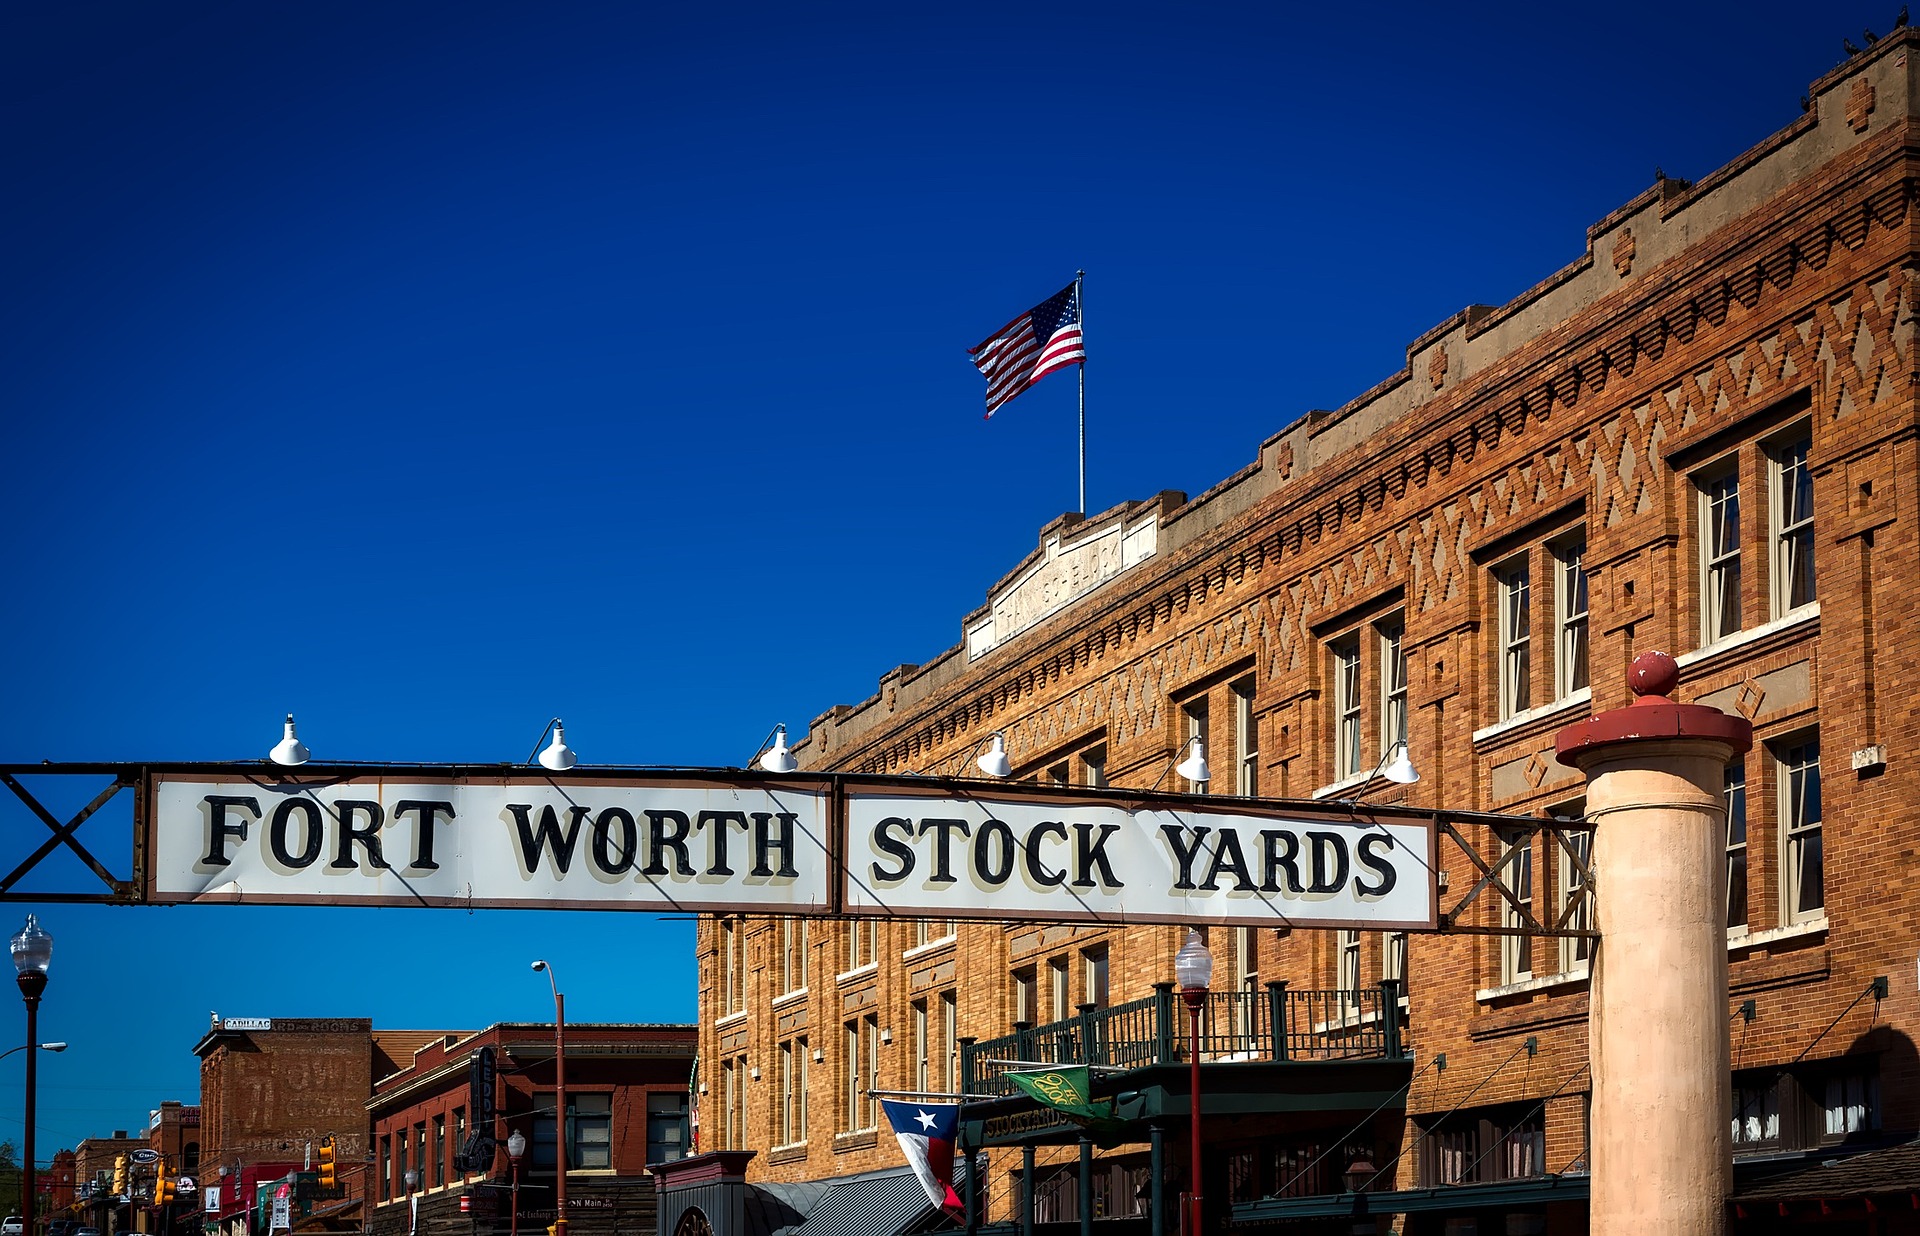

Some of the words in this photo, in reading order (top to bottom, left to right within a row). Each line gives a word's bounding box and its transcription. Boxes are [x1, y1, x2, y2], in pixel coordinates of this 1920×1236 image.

[201, 794, 455, 870] FORT
[505, 803, 799, 879] WORTH
[871, 816, 1125, 888] STOCK
[1159, 824, 1398, 897] YARDS
[225, 1020, 270, 1029] CADILLAC
[310, 1022, 359, 1032] ROOMS
[576, 1199, 582, 1207] N
[584, 1199, 602, 1207] Main
[527, 1210, 551, 1220] Exchange
